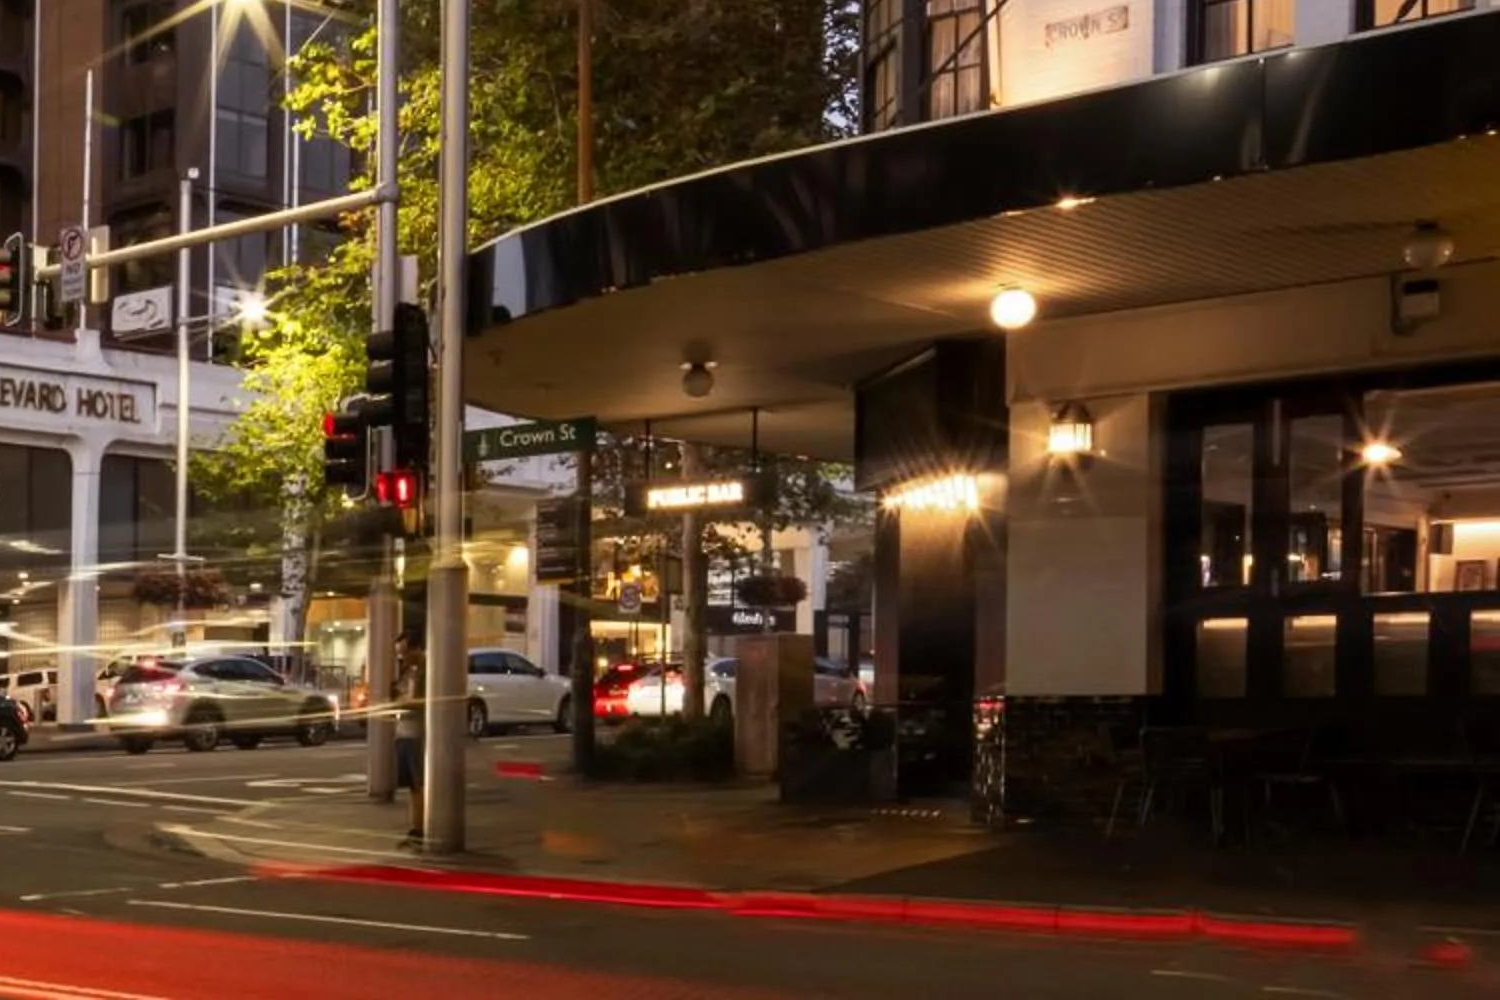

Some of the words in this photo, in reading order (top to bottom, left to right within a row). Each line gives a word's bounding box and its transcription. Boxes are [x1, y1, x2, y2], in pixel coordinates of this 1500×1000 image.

[76, 387, 141, 424] HOTEL
[500, 430, 555, 447] Crown
[560, 423, 577, 441] St
